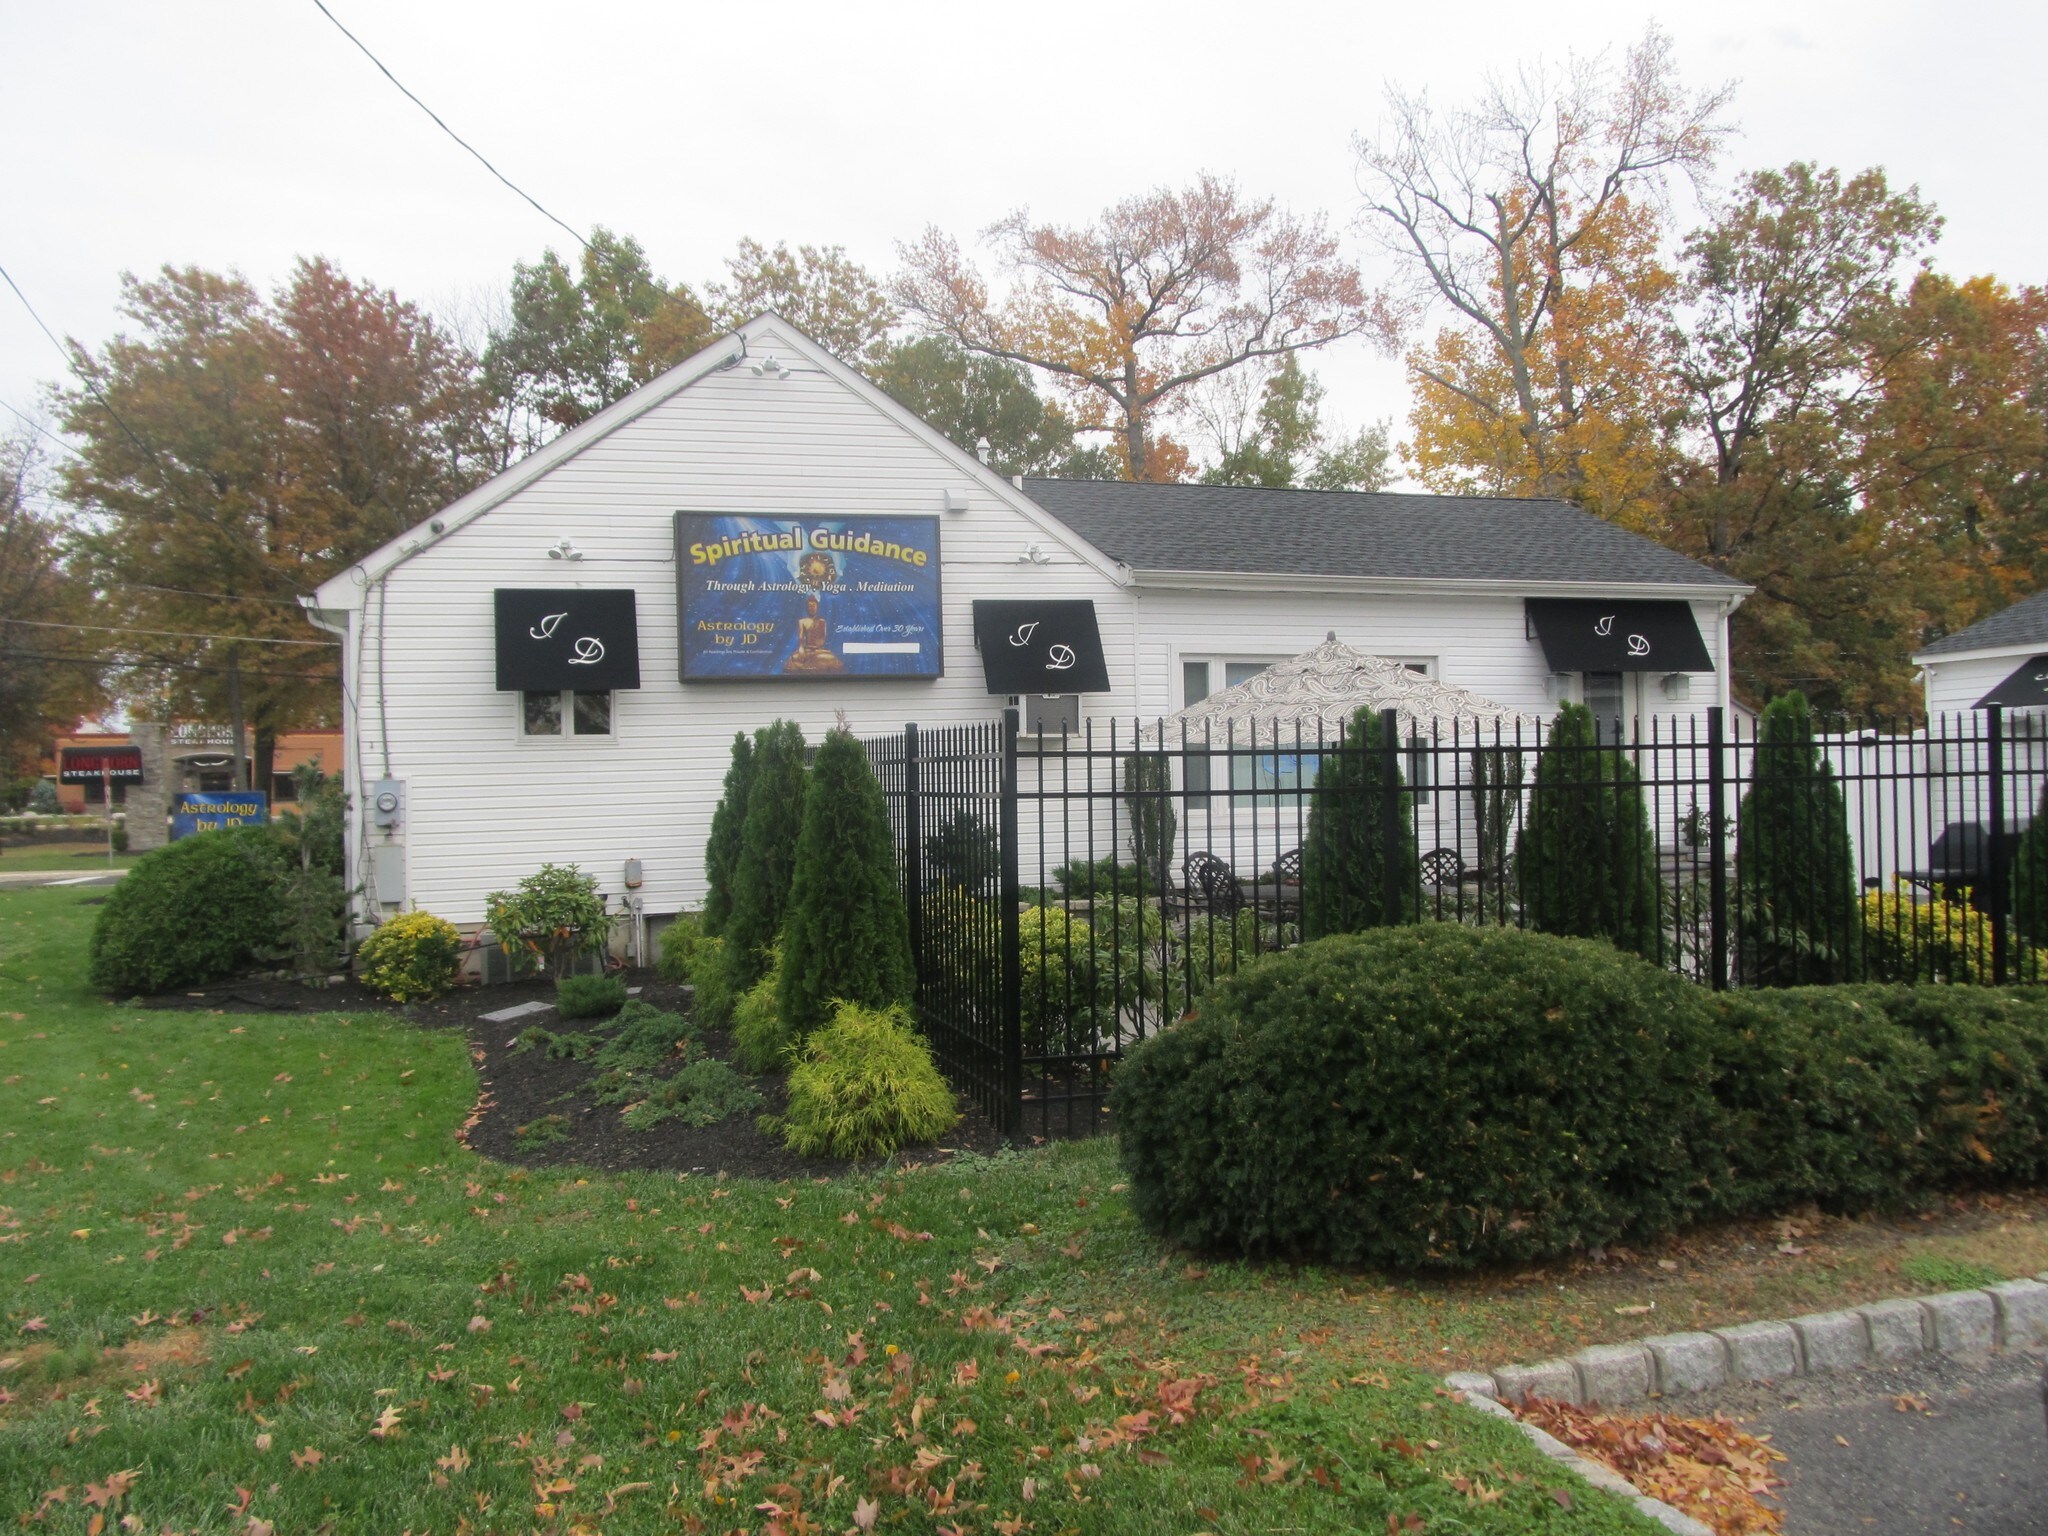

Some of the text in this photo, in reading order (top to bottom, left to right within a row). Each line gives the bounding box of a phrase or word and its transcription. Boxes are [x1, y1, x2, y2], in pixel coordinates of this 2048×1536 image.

[689, 528, 928, 567] Spiritual Guidance
[706, 580, 914, 593] Through Astrology Yoga Meditation
[697, 620, 775, 633] Astrology
[715, 633, 757, 646] by JD
[180, 801, 258, 816] Astrology
